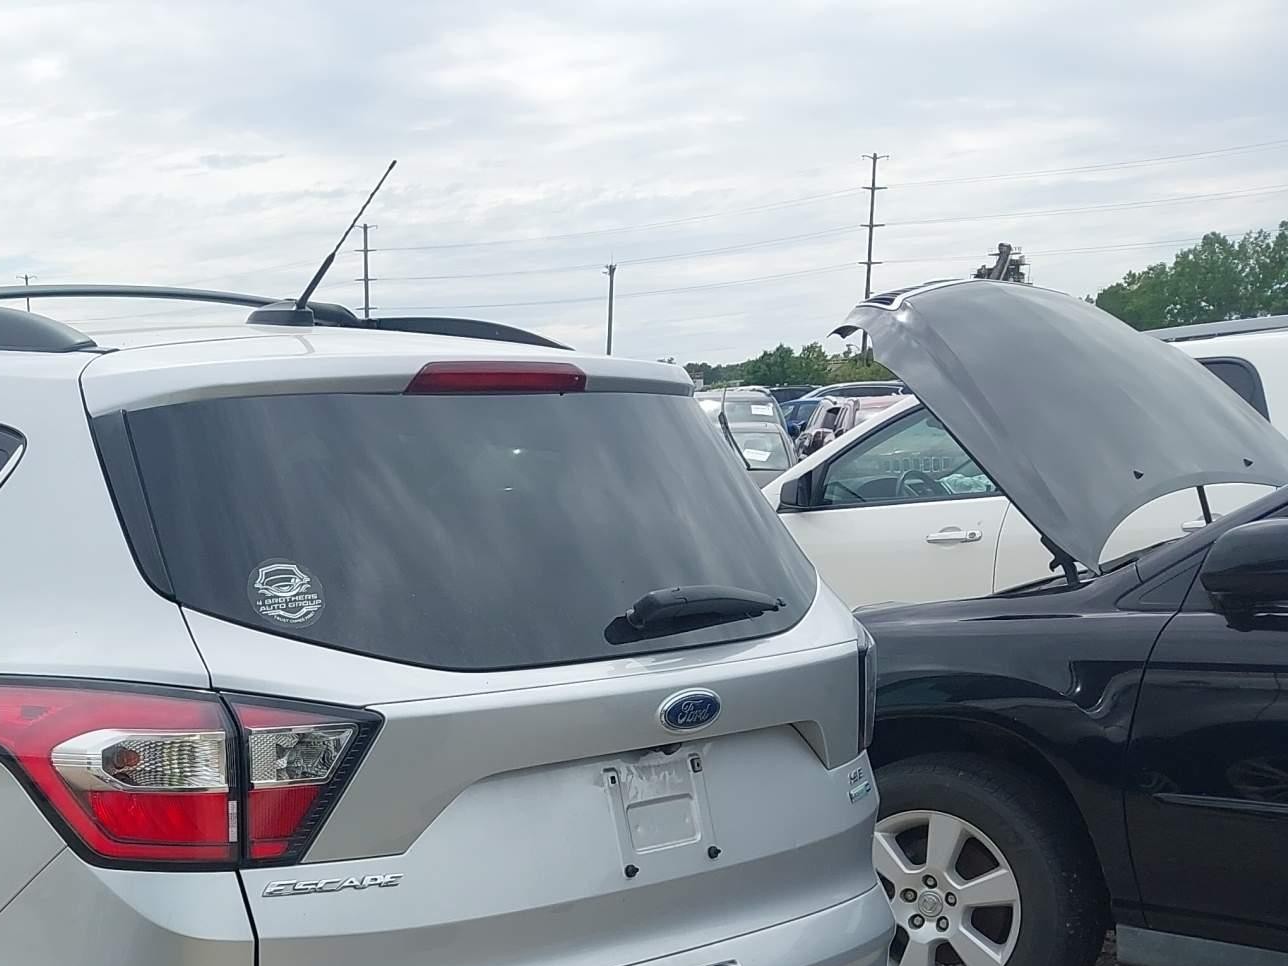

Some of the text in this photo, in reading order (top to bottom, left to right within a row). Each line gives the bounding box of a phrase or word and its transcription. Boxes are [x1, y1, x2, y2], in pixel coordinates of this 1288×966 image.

[259, 599, 322, 612] AUTO GROUP
[264, 594, 318, 605] BROTHERS
[262, 873, 404, 897] ESCAPE
